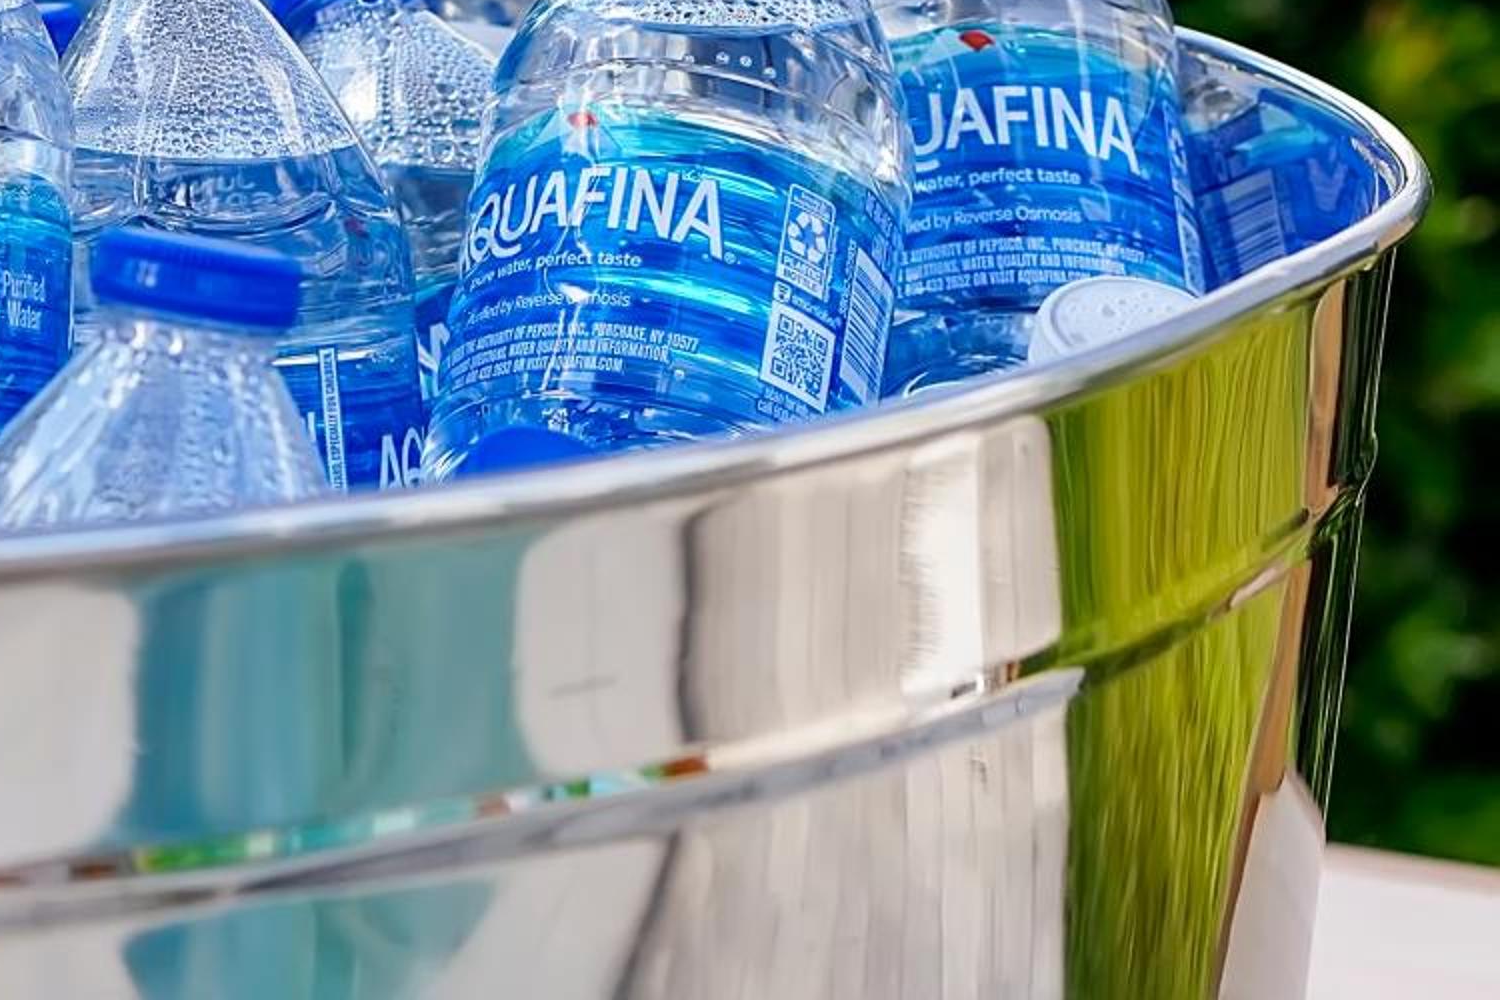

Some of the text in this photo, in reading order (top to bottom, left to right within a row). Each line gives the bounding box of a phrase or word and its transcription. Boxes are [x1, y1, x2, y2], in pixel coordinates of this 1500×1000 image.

[914, 85, 1142, 176] UAFINA
[969, 168, 1033, 187] perfect
[1036, 168, 1082, 185] taste
[934, 213, 951, 231] by
[954, 207, 1013, 225] Reverse
[1015, 205, 1083, 224] Osmosis
[536, 251, 592, 271] perfect
[598, 251, 643, 268] taste
[961, 255, 995, 271] WATER
[996, 252, 1038, 272] QUALITY
[3, 270, 45, 302] Purified
[515, 292, 563, 309] Reverse
[566, 291, 632, 307] Omosis
[7, 299, 42, 330] Water
[650, 328, 665, 344] NY
[667, 332, 700, 353] 10577
